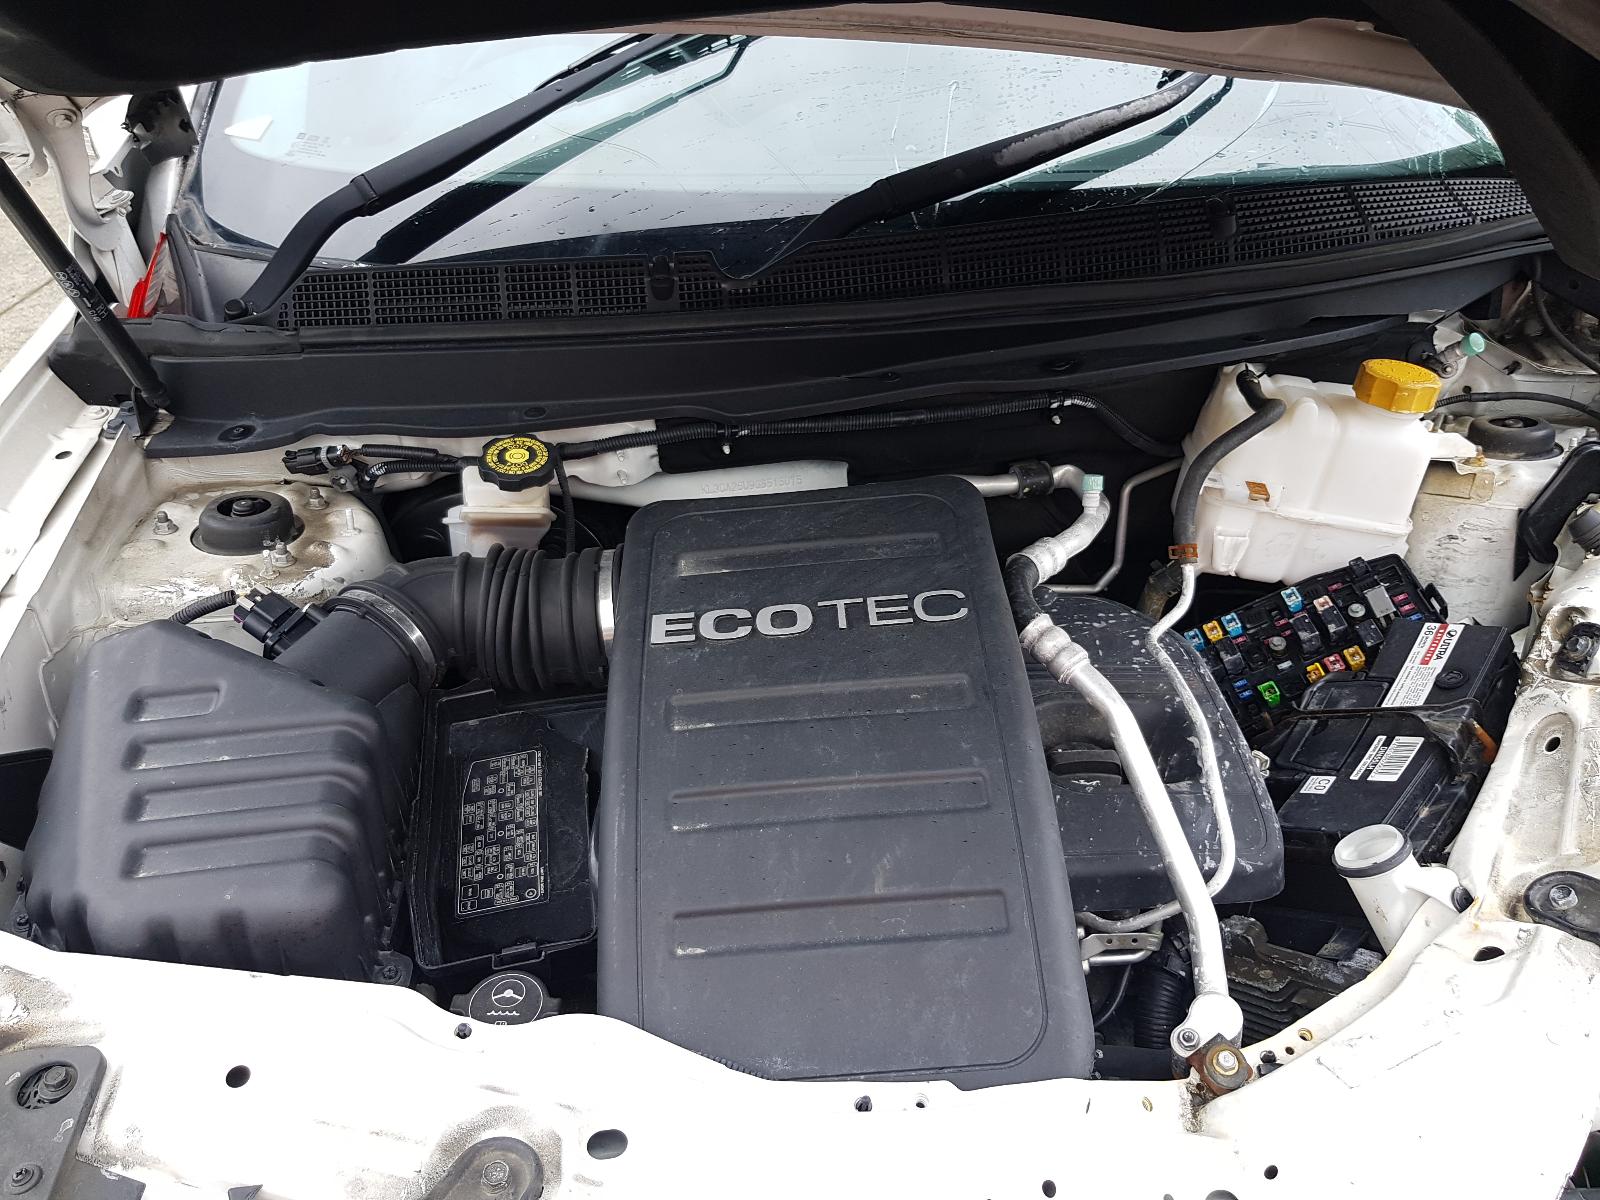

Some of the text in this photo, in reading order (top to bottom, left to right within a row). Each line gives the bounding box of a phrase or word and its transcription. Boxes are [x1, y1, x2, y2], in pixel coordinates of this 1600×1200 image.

[651, 589, 969, 645] ECOTEC
[1424, 625, 1436, 635] 36
[1423, 630, 1443, 660] BATTERIES
[1433, 638, 1451, 660] ULTRA
